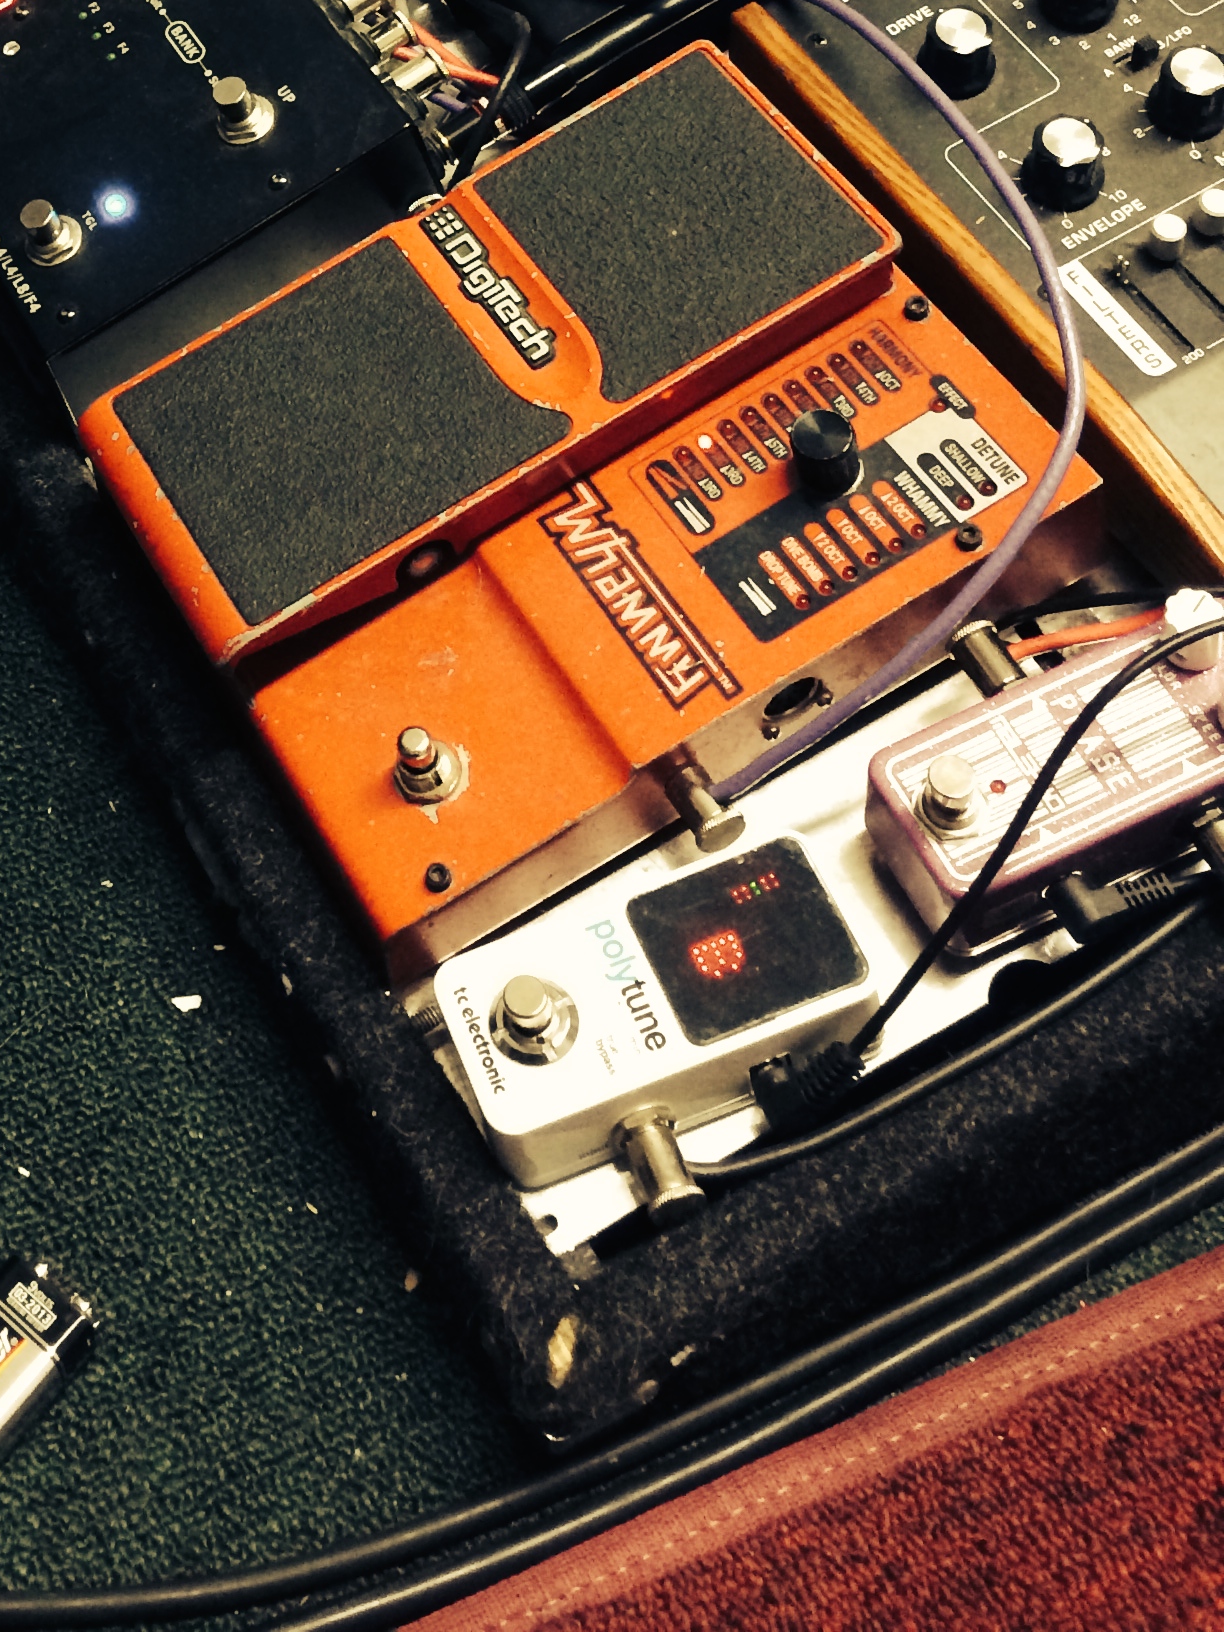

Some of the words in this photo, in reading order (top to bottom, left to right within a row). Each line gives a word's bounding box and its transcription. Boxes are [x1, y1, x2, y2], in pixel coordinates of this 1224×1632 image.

[87, 0, 102, 14] F2
[102, 21, 116, 35] F3
[885, 4, 936, 37] DRIVE
[1025, 19, 1038, 32] 4
[1122, 12, 1143, 28] 12
[170, 24, 201, 60] BANK
[1047, 34, 1062, 48] 3
[1078, 39, 1092, 52] 2
[1104, 35, 1138, 59] BANK
[1106, 31, 1118, 44] 1
[276, 84, 298, 104] UP
[1122, 83, 1135, 94] 4
[1132, 127, 1147, 140] 2
[996, 149, 1009, 161] 4
[1188, 149, 1203, 161] 0
[1107, 188, 1129, 204] 10
[80, 209, 99, 232] TGL
[1060, 217, 1074, 230] 0
[1060, 198, 1147, 251] ENVELOPE
[445, 233, 551, 362] DigiTech
[1066, 269, 1163, 370] FILTERS
[1180, 347, 1206, 366] 200
[937, 381, 969, 411] EFFECT
[944, 443, 988, 484] SHALLOW
[970, 437, 1021, 486] DETUNE
[928, 464, 955, 489] DEEP
[893, 470, 952, 528] WHAMMY
[781, 536, 802, 559] DIVE
[797, 554, 825, 583] BOMB
[758, 550, 783, 575] DROP
[777, 572, 803, 597] TUNE
[1049, 693, 1134, 795] PASE
[585, 919, 667, 1051] polytune
[453, 986, 469, 1005] tc
[461, 1005, 506, 1096] electronic
[13, 1287, 52, 1326] 03-2013
